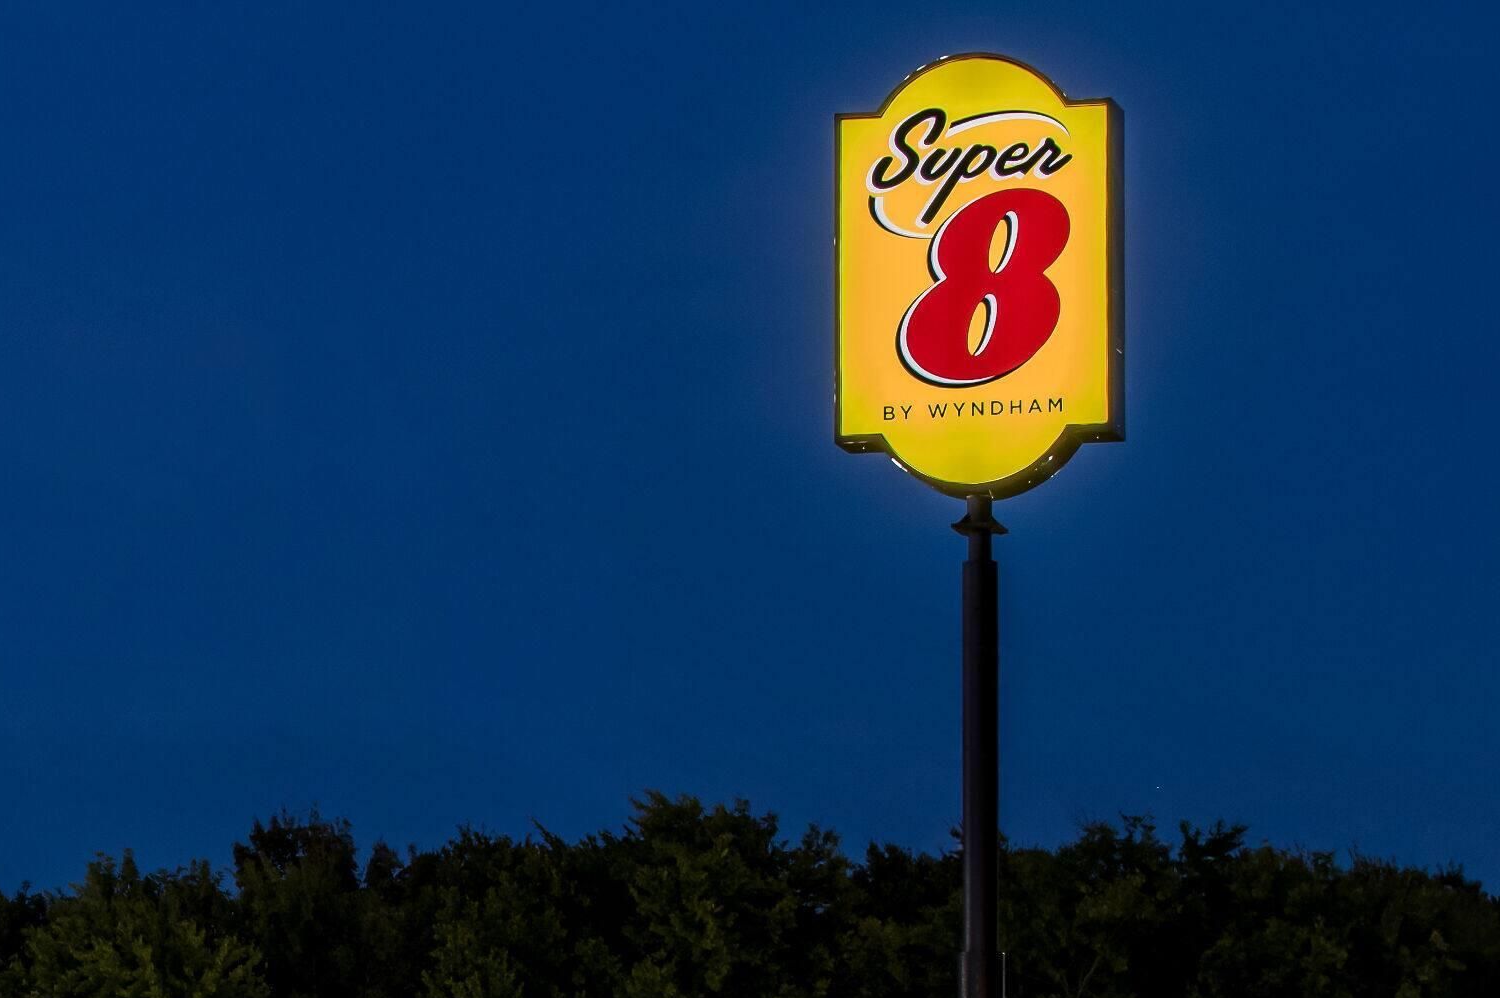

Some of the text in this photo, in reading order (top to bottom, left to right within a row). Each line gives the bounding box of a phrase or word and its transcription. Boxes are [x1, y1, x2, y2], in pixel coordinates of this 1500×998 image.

[868, 108, 1074, 226] Super
[895, 188, 1071, 388] 8
[883, 397, 1064, 421] BY WYNDHAM
